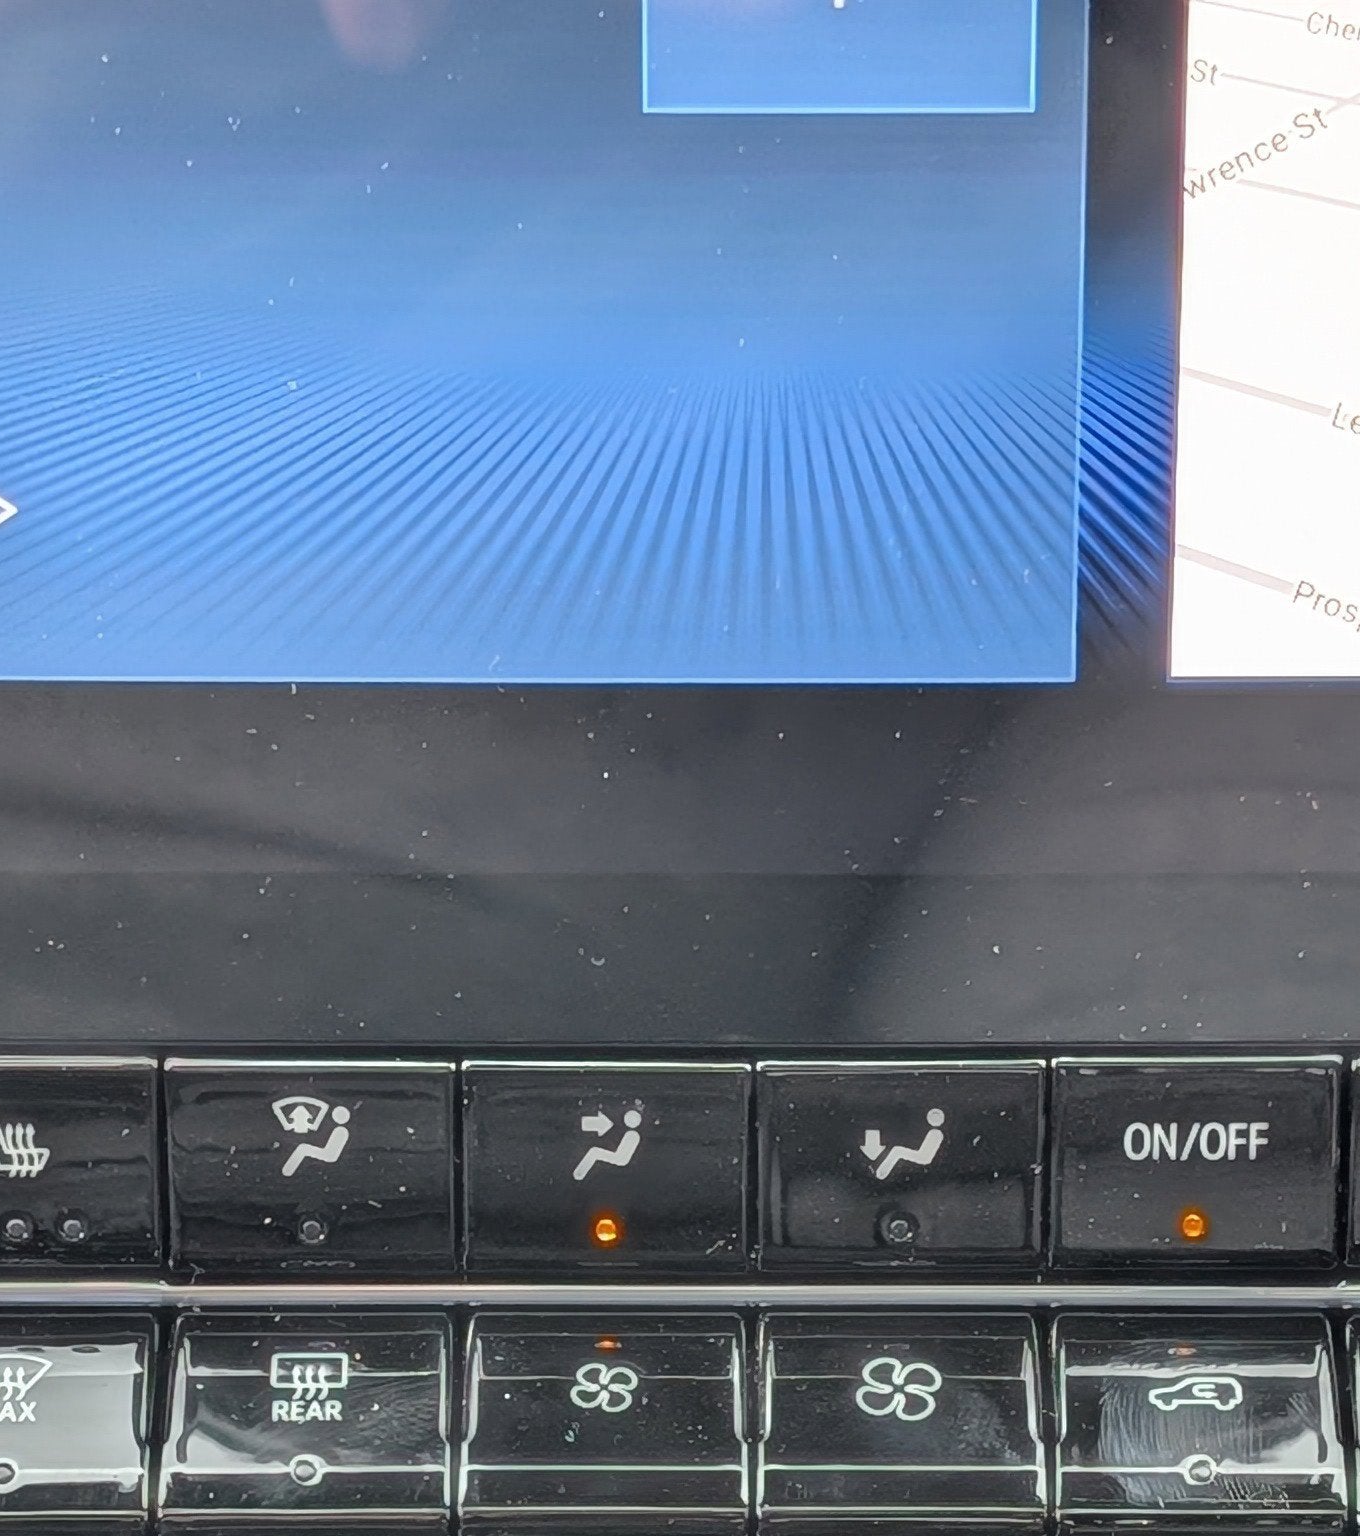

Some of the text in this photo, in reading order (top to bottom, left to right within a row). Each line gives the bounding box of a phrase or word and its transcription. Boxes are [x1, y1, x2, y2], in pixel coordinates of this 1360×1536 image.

[1189, 58, 1219, 86] St
[1183, 108, 1328, 200] wrence St
[1122, 1120, 1270, 1163] ON/OFF
[271, 1399, 343, 1423] REAR
